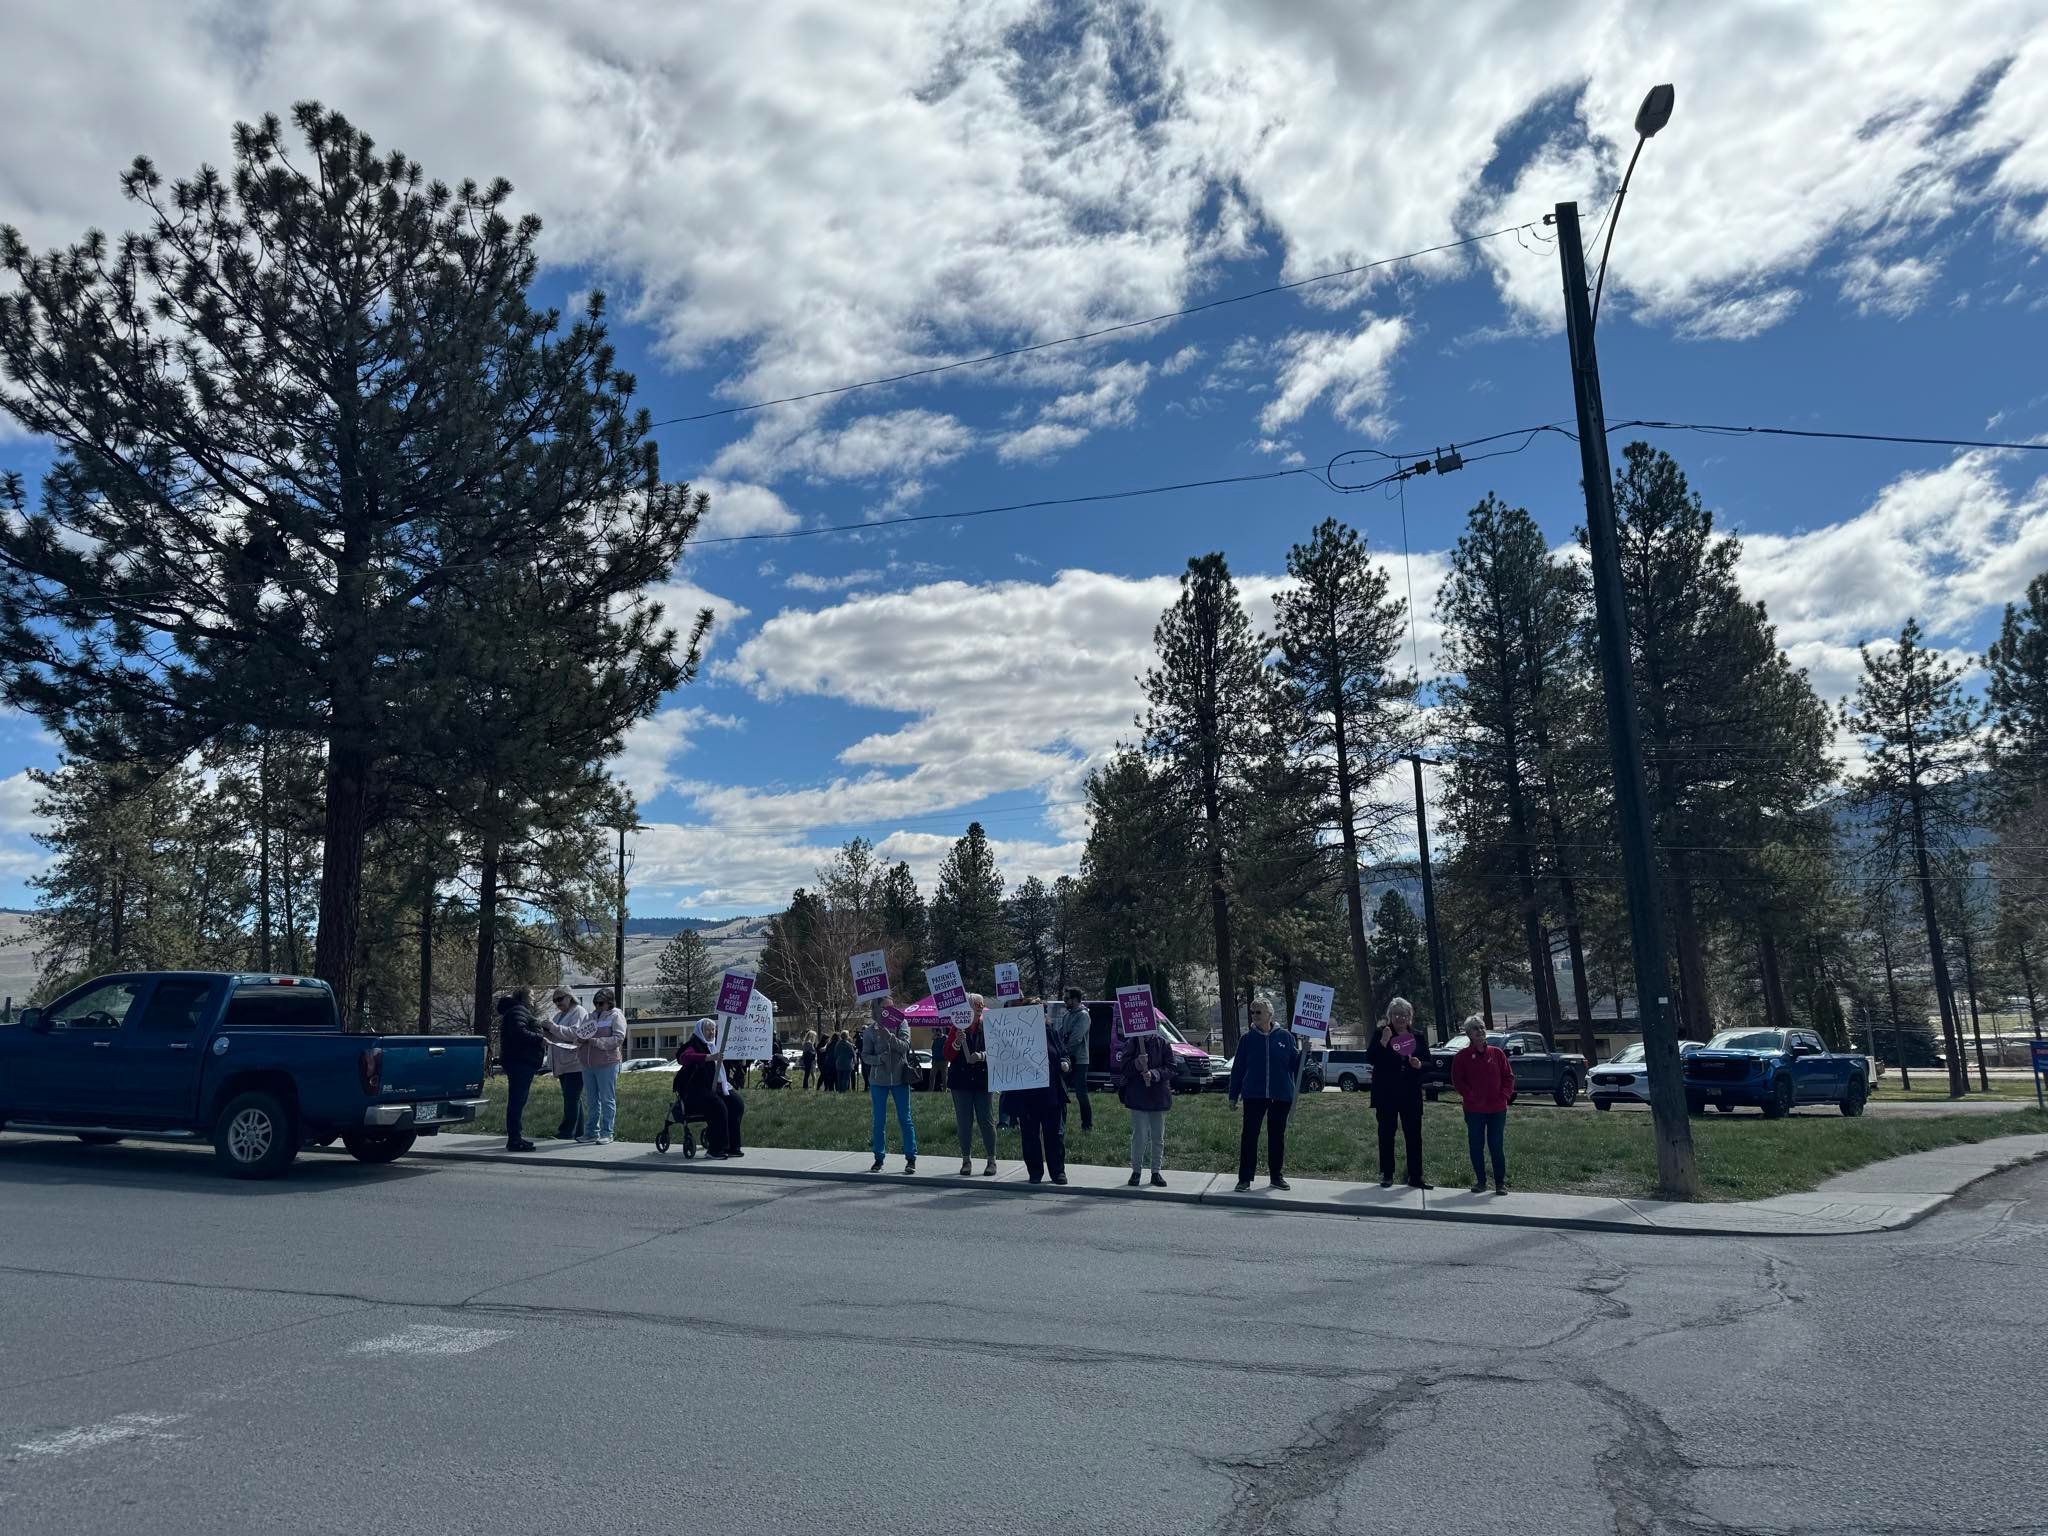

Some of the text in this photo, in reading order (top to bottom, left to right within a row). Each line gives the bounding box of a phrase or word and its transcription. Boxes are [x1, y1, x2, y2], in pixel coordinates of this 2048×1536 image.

[861, 960, 875, 969] SAFE
[856, 966, 883, 978] STAFFING
[732, 978, 745, 986] SAFE
[862, 975, 880, 986] SAVES
[931, 971, 957, 985] PATIENTS
[726, 982, 749, 992] STAFFING
[864, 983, 880, 993] LIVES
[934, 980, 958, 992] DESERVE
[728, 993, 741, 1001] SAFE
[943, 990, 957, 1000] SAFE
[723, 999, 743, 1008] PATIENT
[1123, 1000, 1148, 1009] STAFFING
[1302, 1001, 1325, 1012] PATIENT
[724, 1005, 739, 1013] CARE
[1301, 1009, 1323, 1020] RATIOS
[985, 1013, 1011, 1028] WE
[1128, 1017, 1149, 1025] PATIENT
[1001, 1035, 1035, 1048] WITH
[1000, 1048, 1031, 1060] OUR
